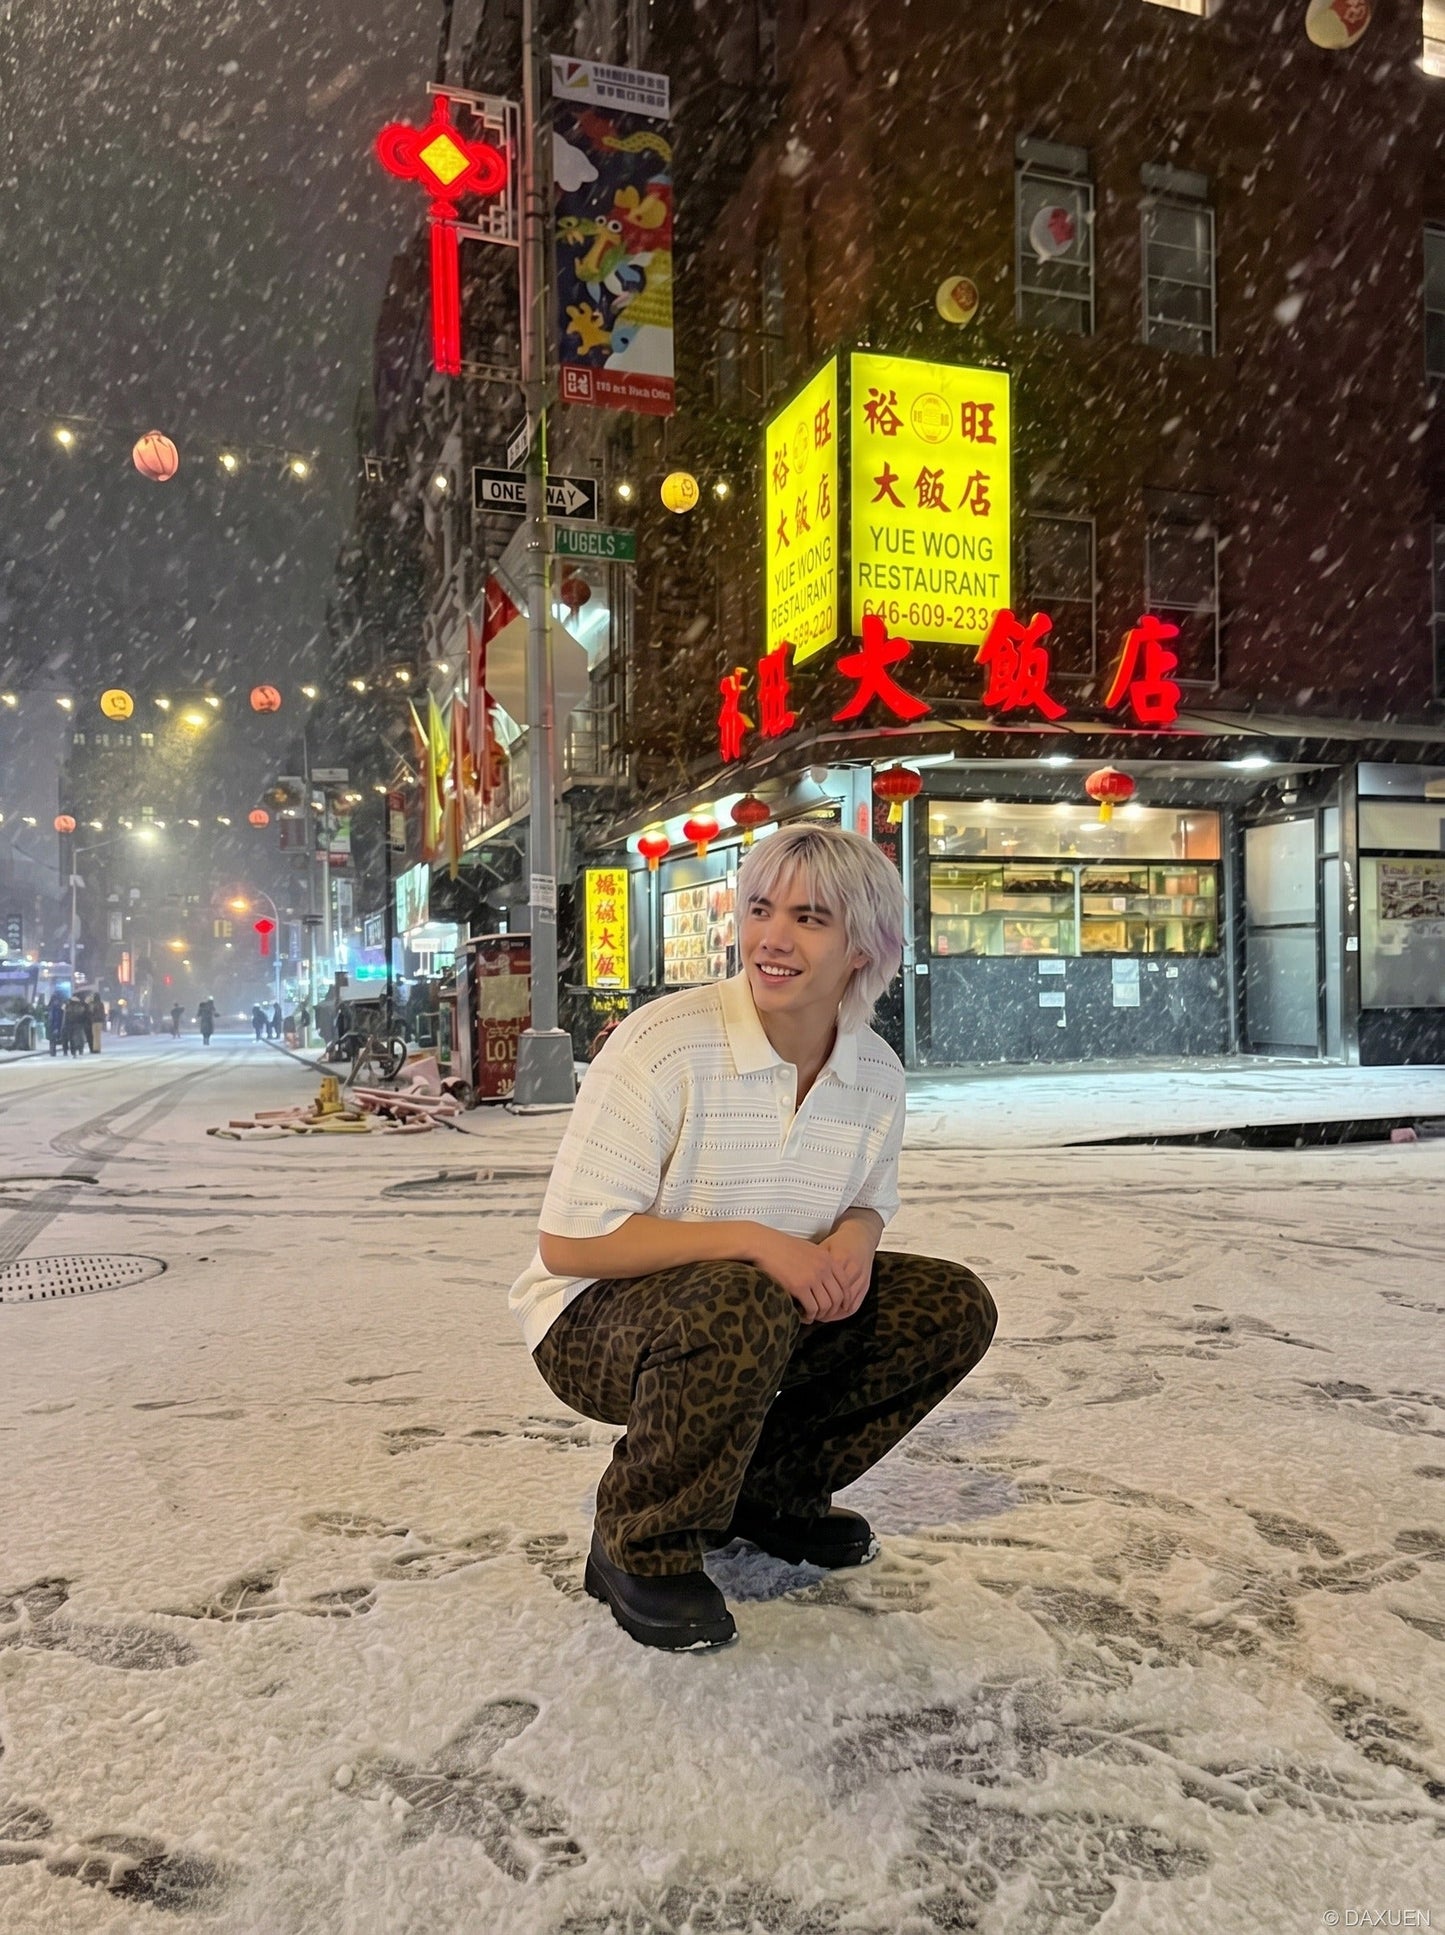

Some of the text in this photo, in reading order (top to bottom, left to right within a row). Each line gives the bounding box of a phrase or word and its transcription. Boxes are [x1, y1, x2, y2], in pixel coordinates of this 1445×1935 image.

[490, 482, 526, 502] ONE
[871, 461, 992, 517] 大飯店
[870, 525, 993, 562] YUE WONG
[774, 536, 832, 596] YUE WONG
[858, 562, 1000, 598] RESTAURANT
[771, 568, 834, 633] RESTAURANT
[863, 599, 1000, 631] 646-609-233
